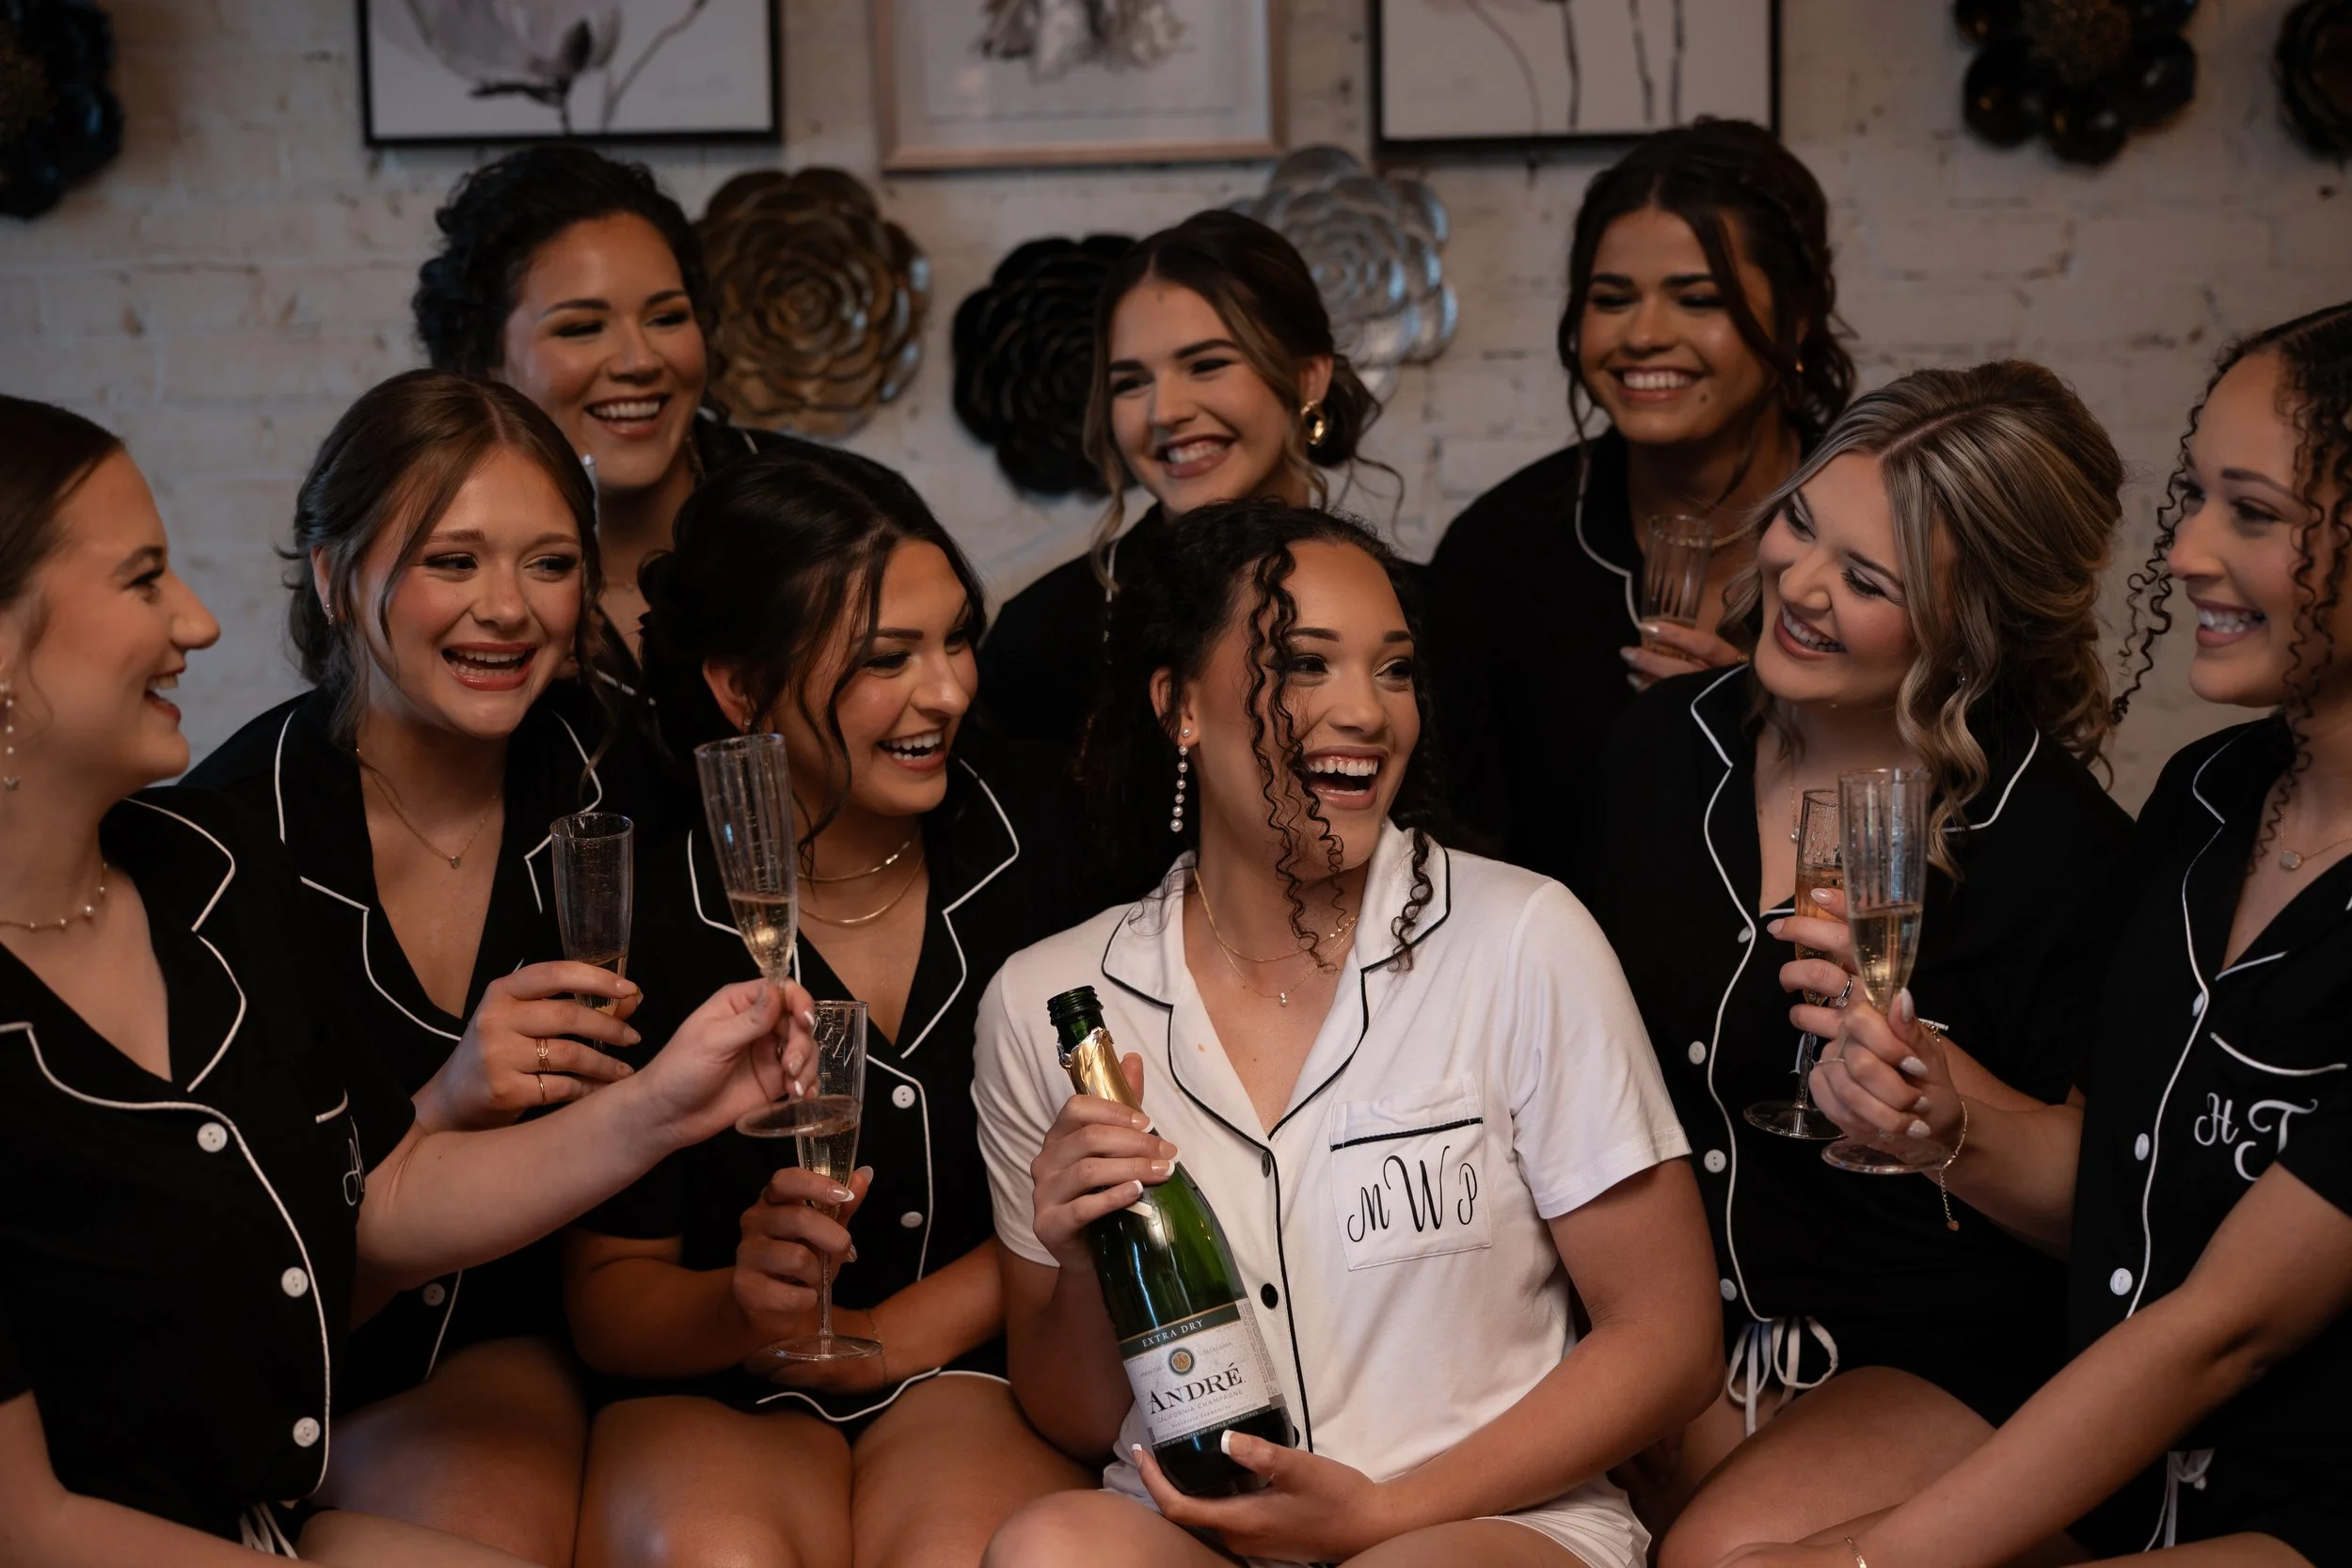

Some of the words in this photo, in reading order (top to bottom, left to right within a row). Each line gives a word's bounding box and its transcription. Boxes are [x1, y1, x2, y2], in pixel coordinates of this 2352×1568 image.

[1141, 1329, 1178, 1348] EXTRA
[1180, 1319, 1204, 1335] DRY
[1148, 1362, 1243, 1415] ANDRÉ
[1157, 1405, 1196, 1423] CALIFORNIA
[1197, 1389, 1243, 1409] CHAMPAGNE
[1209, 1420, 1226, 1431] APPLE
[1227, 1417, 1240, 1425] AND
